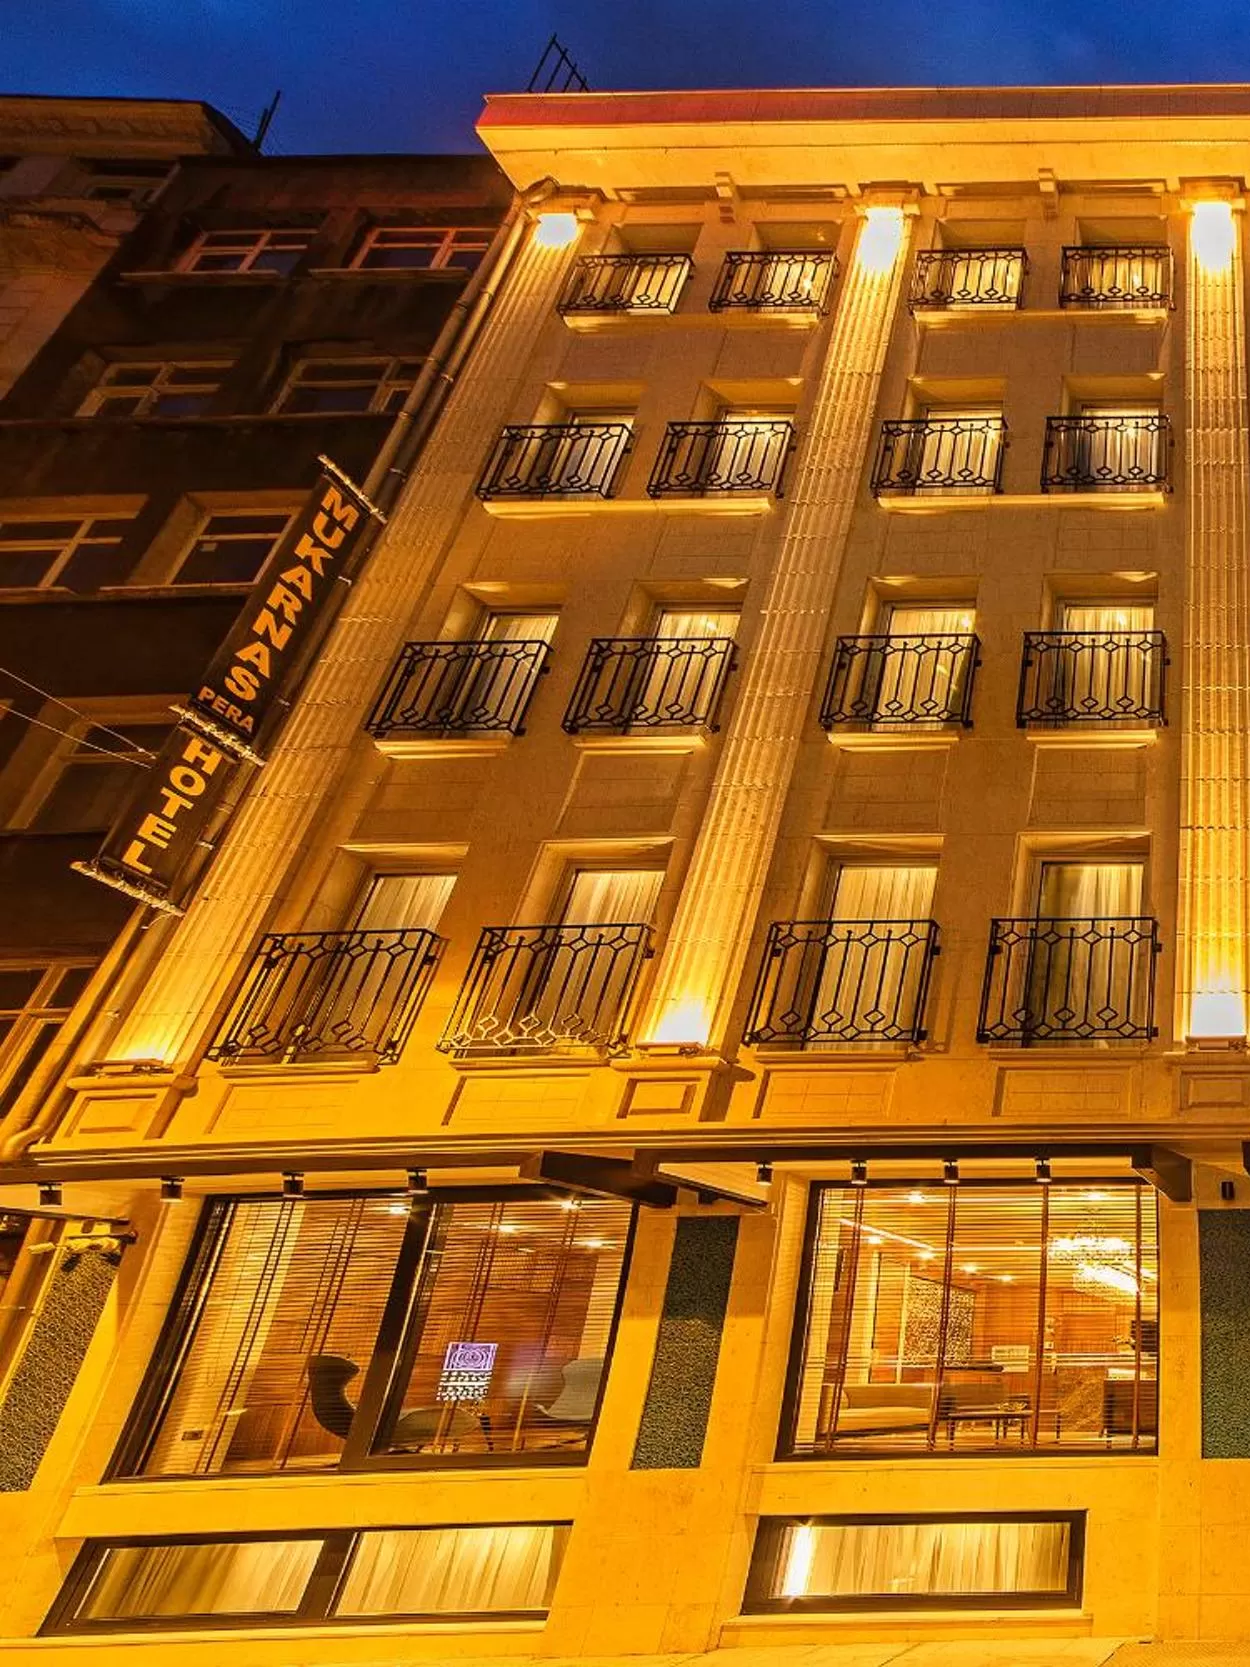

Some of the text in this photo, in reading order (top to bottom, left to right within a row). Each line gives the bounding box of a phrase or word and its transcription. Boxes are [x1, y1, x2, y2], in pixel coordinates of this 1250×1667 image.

[224, 486, 361, 702] MUKARNAS
[197, 685, 256, 735] PERA
[121, 735, 224, 875] HOTEL
